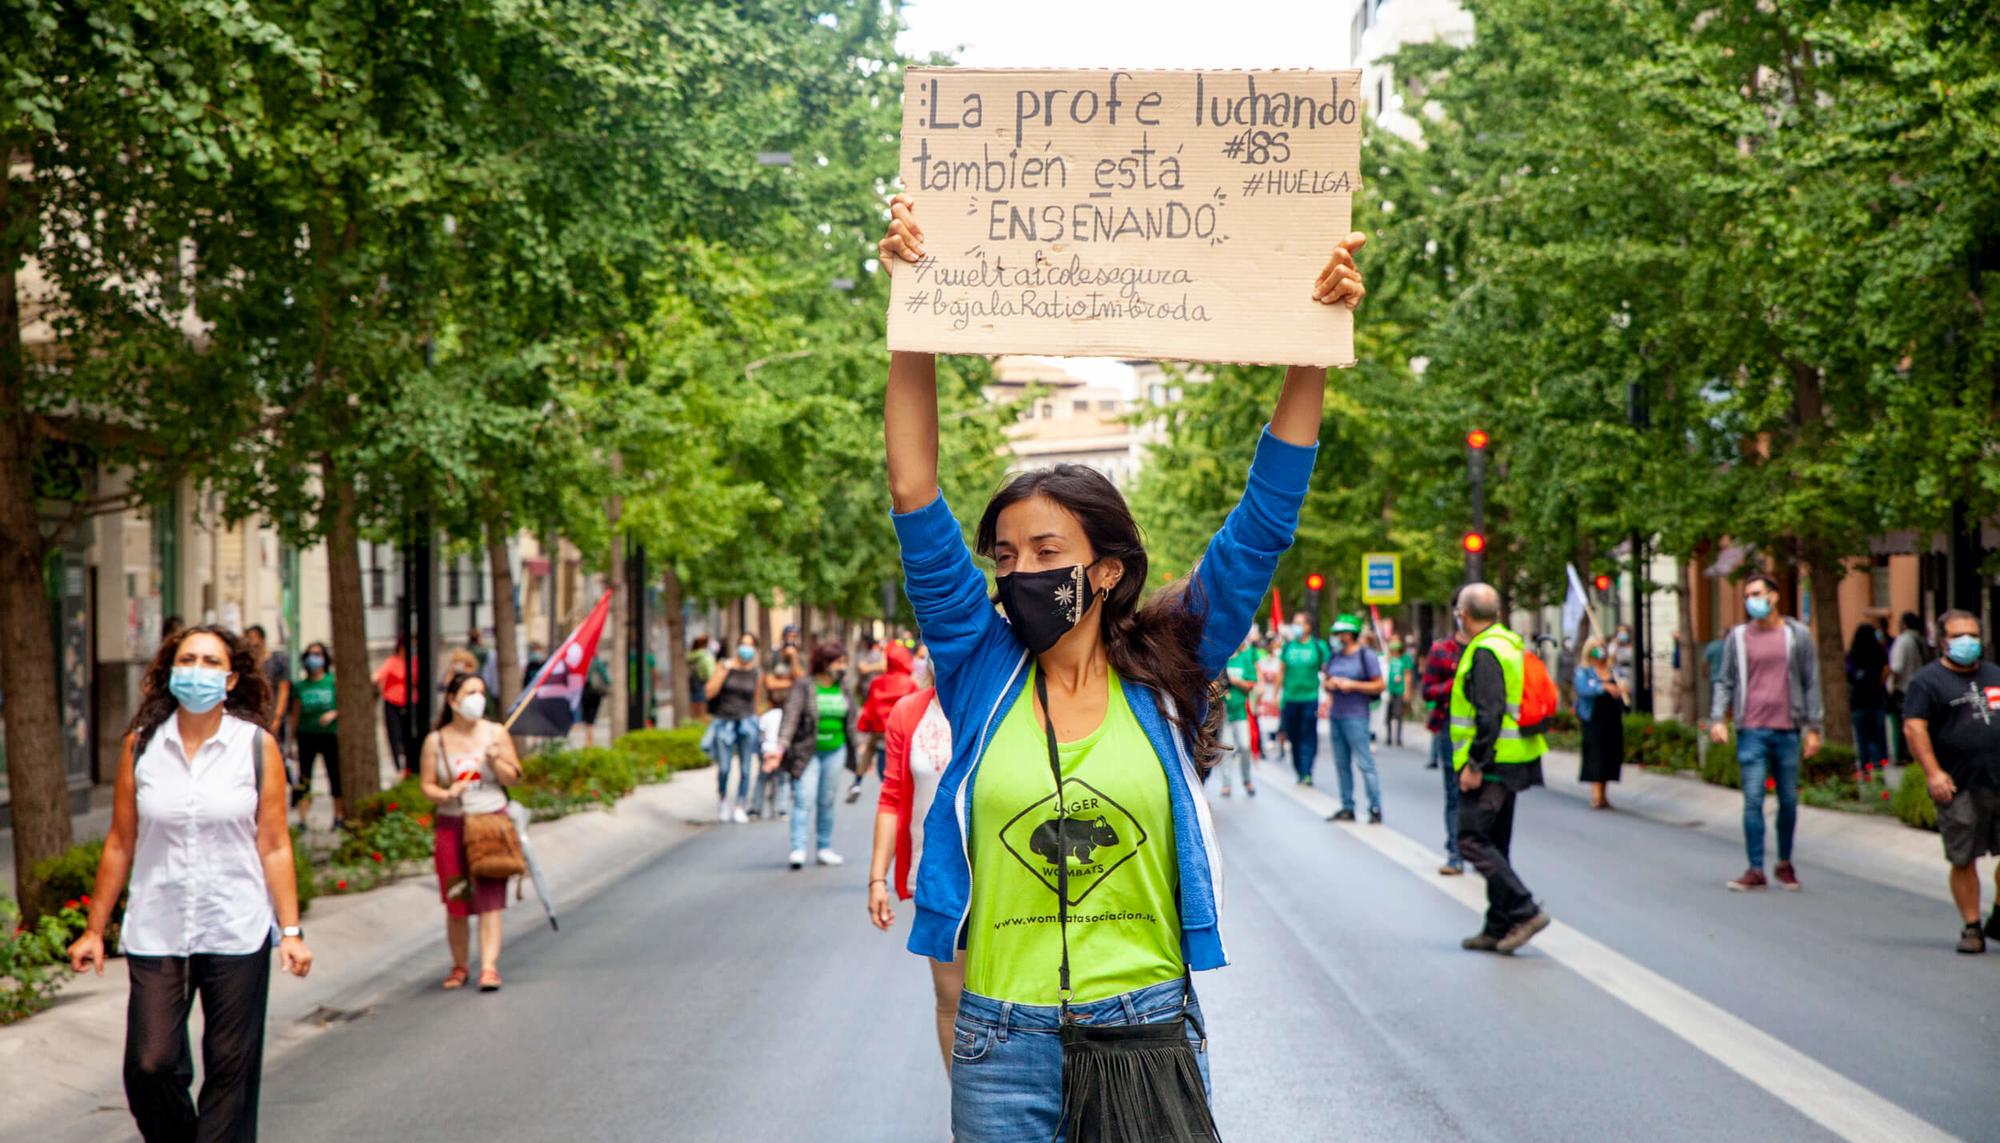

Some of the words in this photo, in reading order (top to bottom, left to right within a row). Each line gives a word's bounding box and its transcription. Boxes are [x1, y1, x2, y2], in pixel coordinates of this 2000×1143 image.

[1015, 71, 1163, 148] profe
[1195, 72, 1356, 130] luchando
[911, 137, 1067, 193] también
[1094, 130, 1185, 190] está
[1242, 168, 1351, 197] #HUELGA
